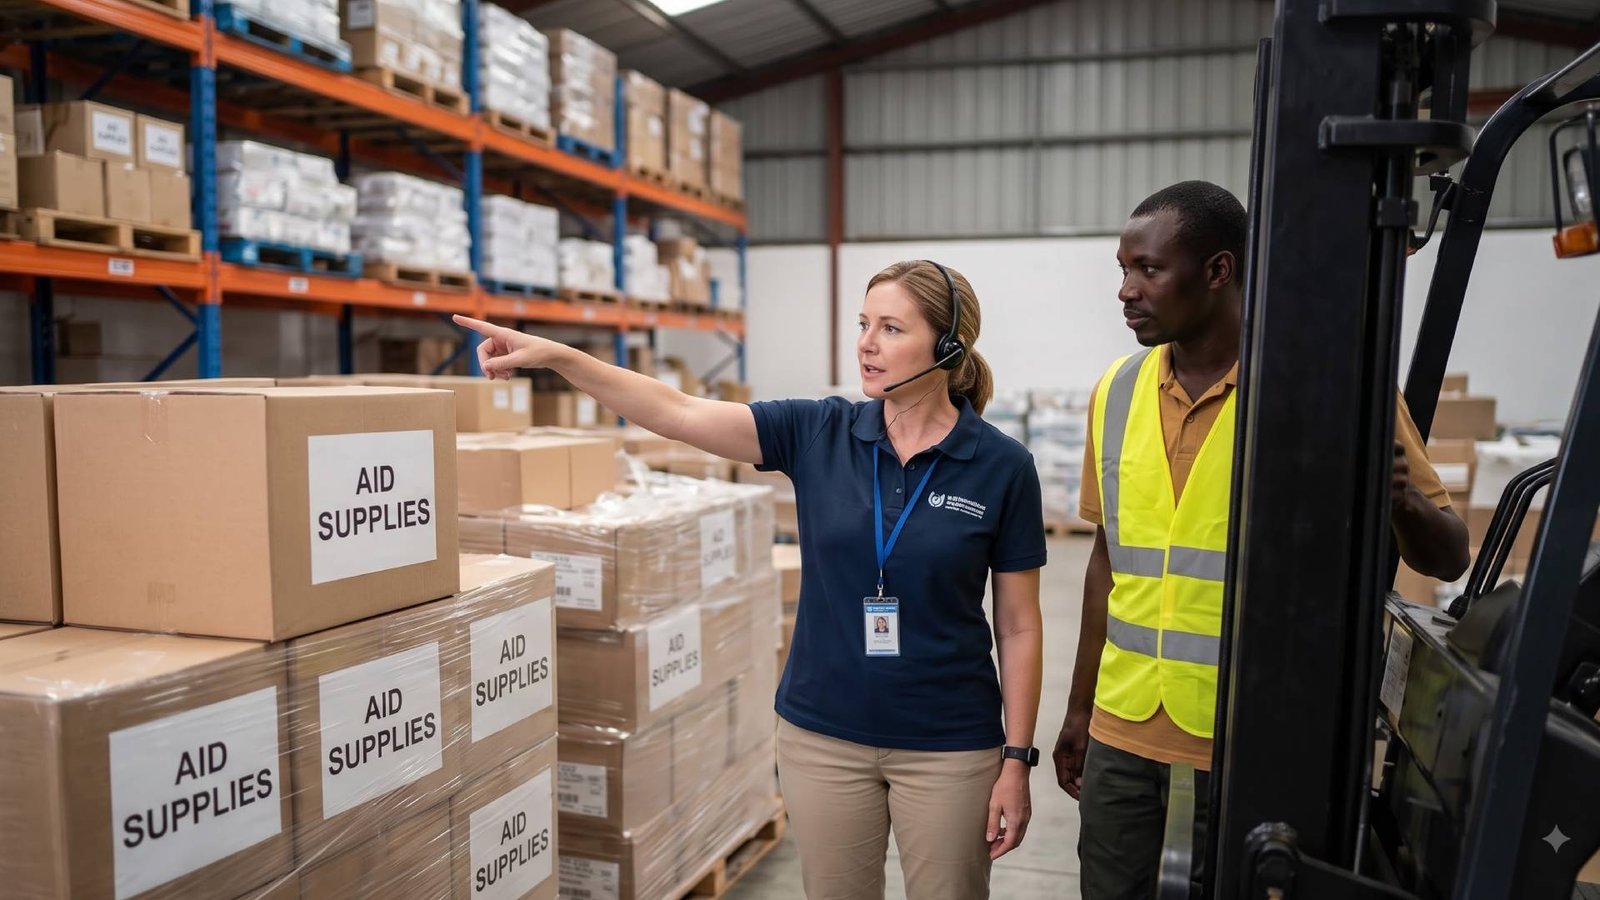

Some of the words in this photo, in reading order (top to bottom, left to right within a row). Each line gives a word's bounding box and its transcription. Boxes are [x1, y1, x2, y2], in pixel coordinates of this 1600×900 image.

[356, 465, 395, 495] AID
[318, 498, 430, 541] SUPPLIES
[499, 634, 526, 664] AID
[668, 633, 685, 655] AID
[476, 656, 548, 706] SUPPLIES
[652, 650, 699, 687] SUPPLIES
[364, 687, 403, 724] AID
[174, 741, 227, 786] AID
[328, 712, 436, 775] SUPPLIES
[123, 768, 273, 848] SUPPLIES
[500, 811, 526, 846] AID
[476, 828, 549, 892] SUPPLIES
